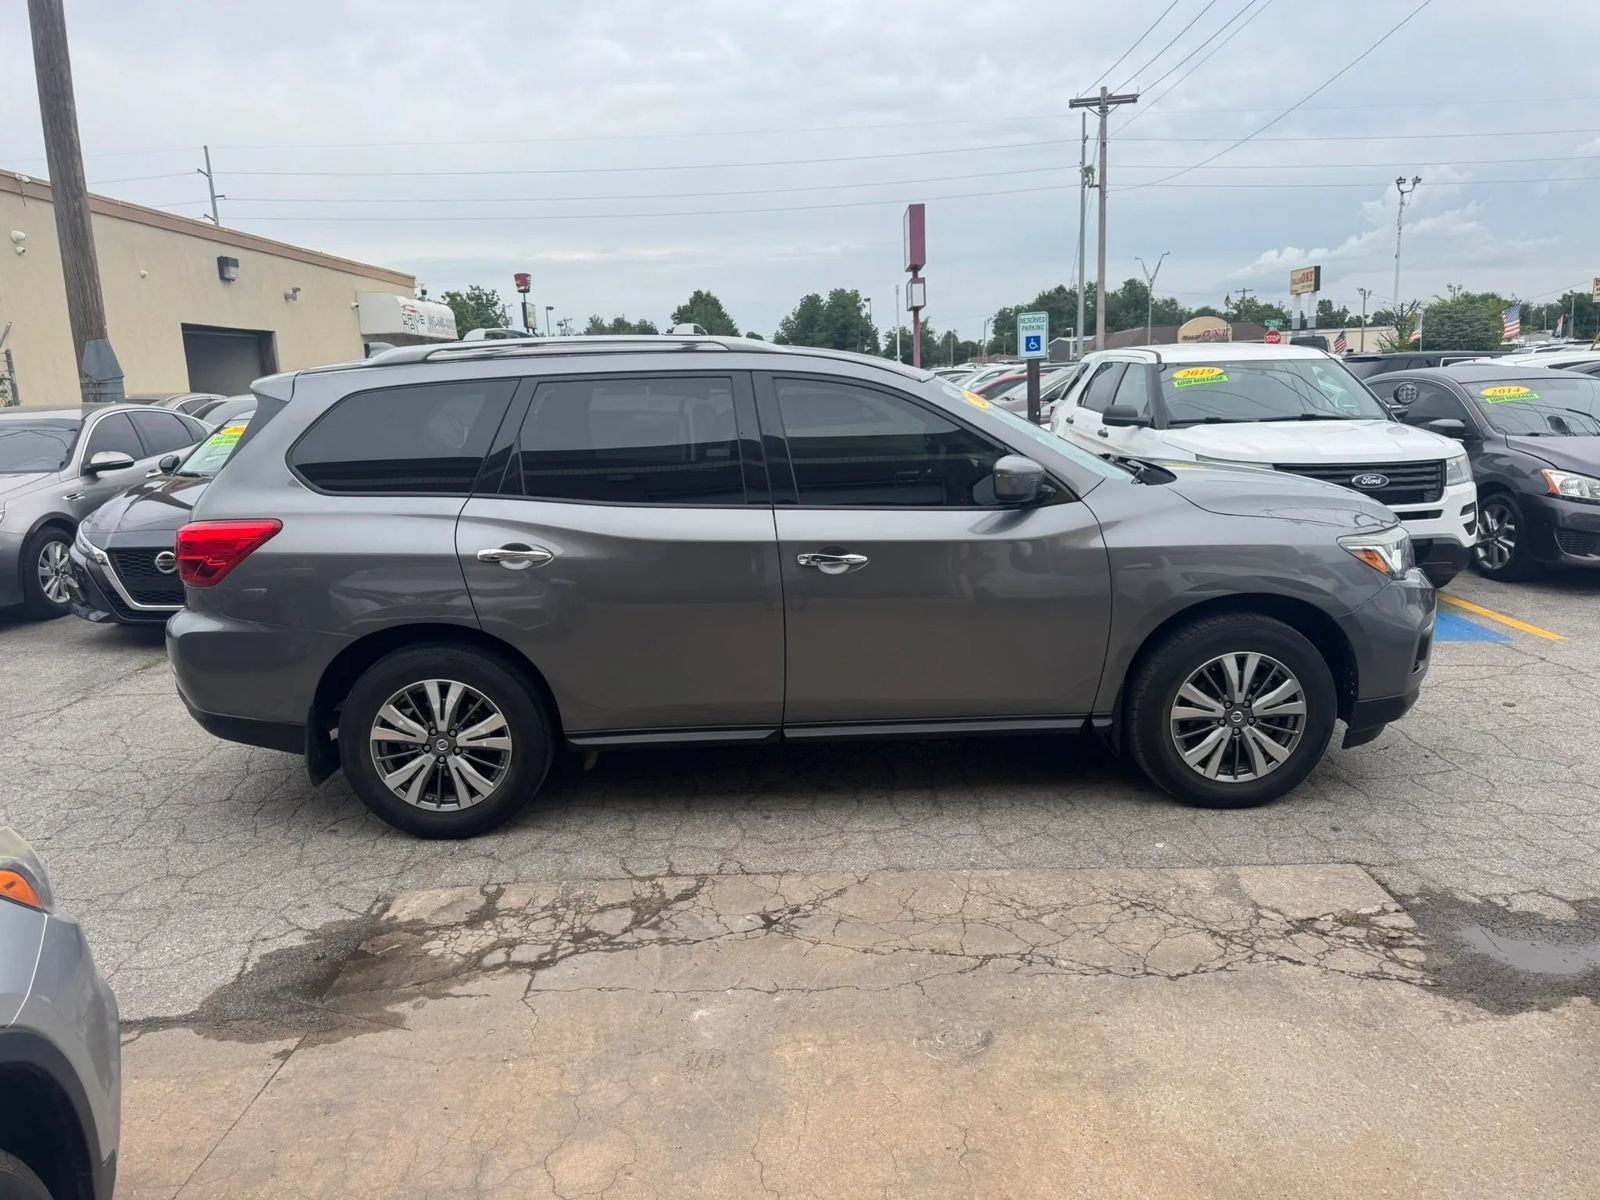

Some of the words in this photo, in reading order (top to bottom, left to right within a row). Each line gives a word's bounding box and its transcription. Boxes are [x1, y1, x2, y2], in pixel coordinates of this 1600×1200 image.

[1020, 316, 1046, 324] RESERVED
[1265, 334, 1280, 342] STOP
[1182, 368, 1215, 378] 2019
[1491, 387, 1520, 395] 2014
[1361, 475, 1382, 485] Ford
